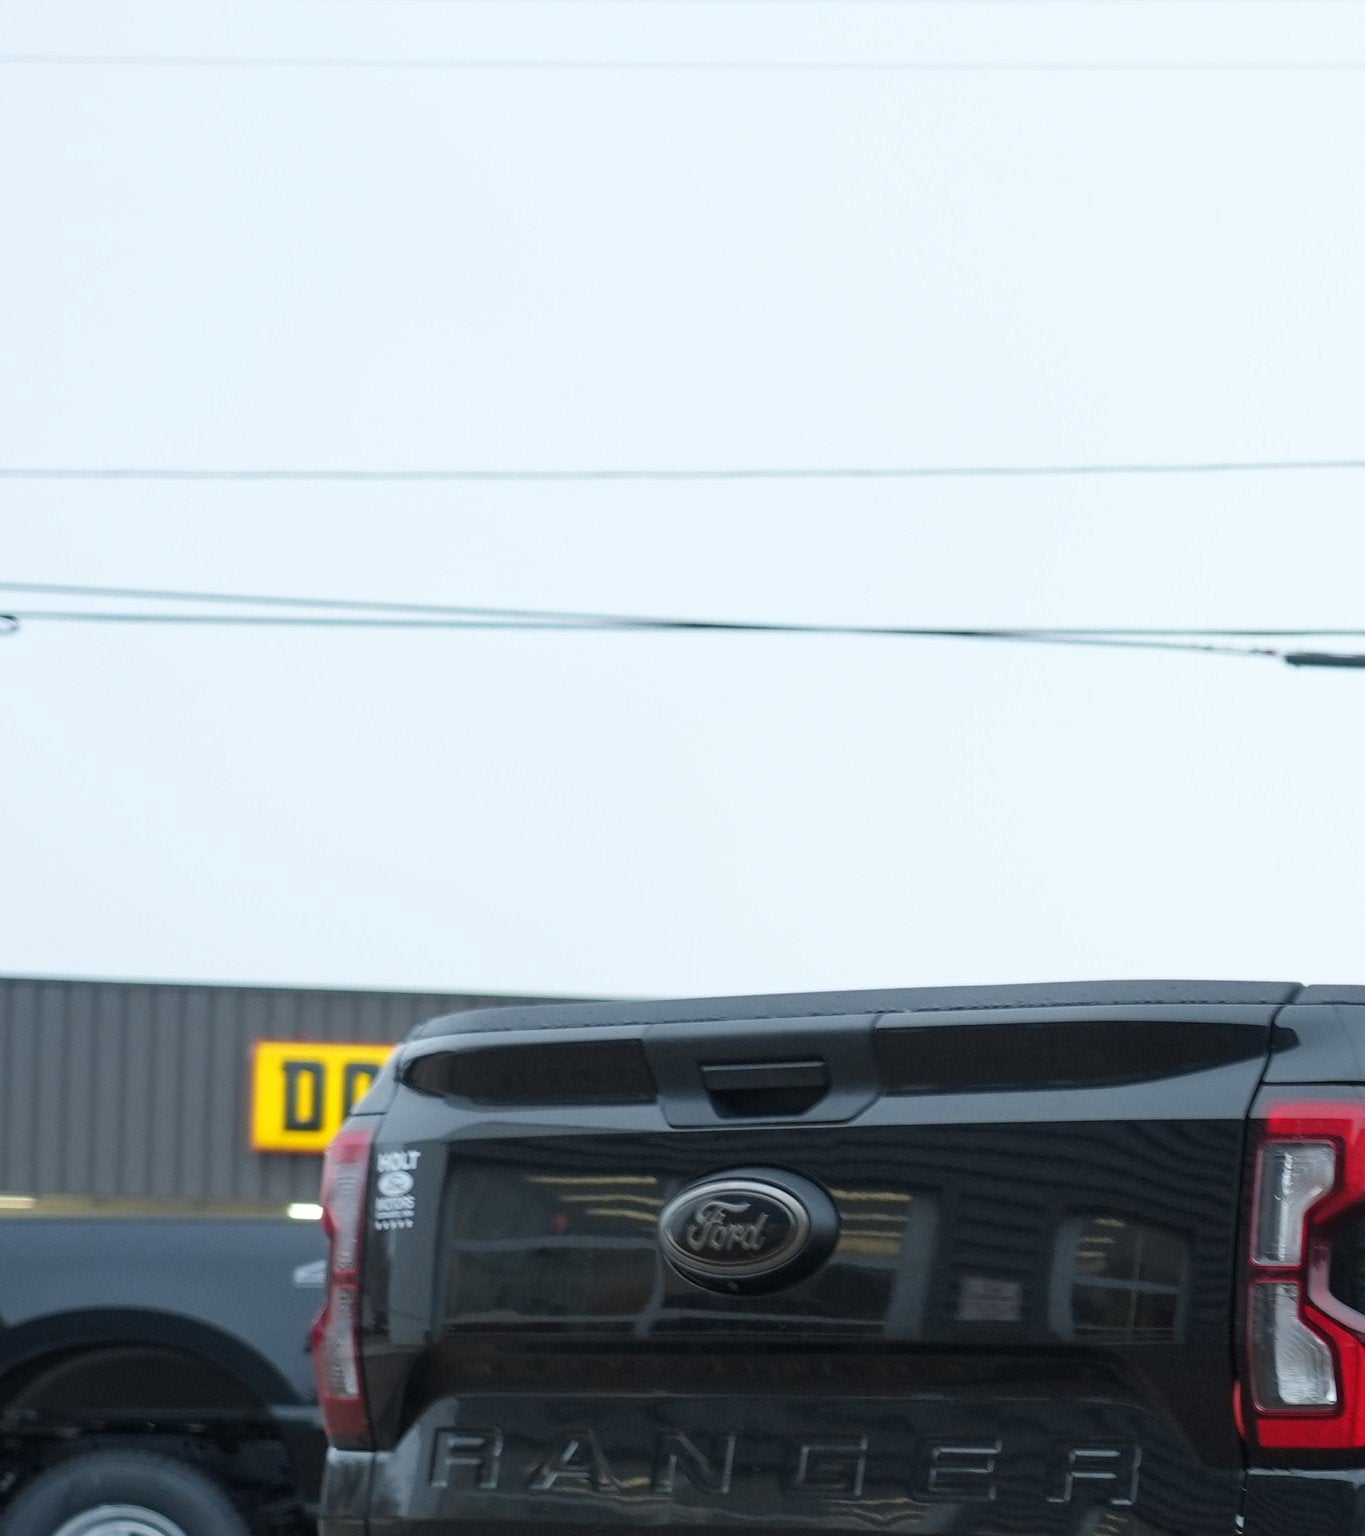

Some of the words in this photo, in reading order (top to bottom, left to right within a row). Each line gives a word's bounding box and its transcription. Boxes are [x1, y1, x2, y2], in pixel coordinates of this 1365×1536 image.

[377, 1150, 421, 1172] HOLT
[686, 1201, 770, 1251] Ford
[428, 1425, 1143, 1506] RANGER
